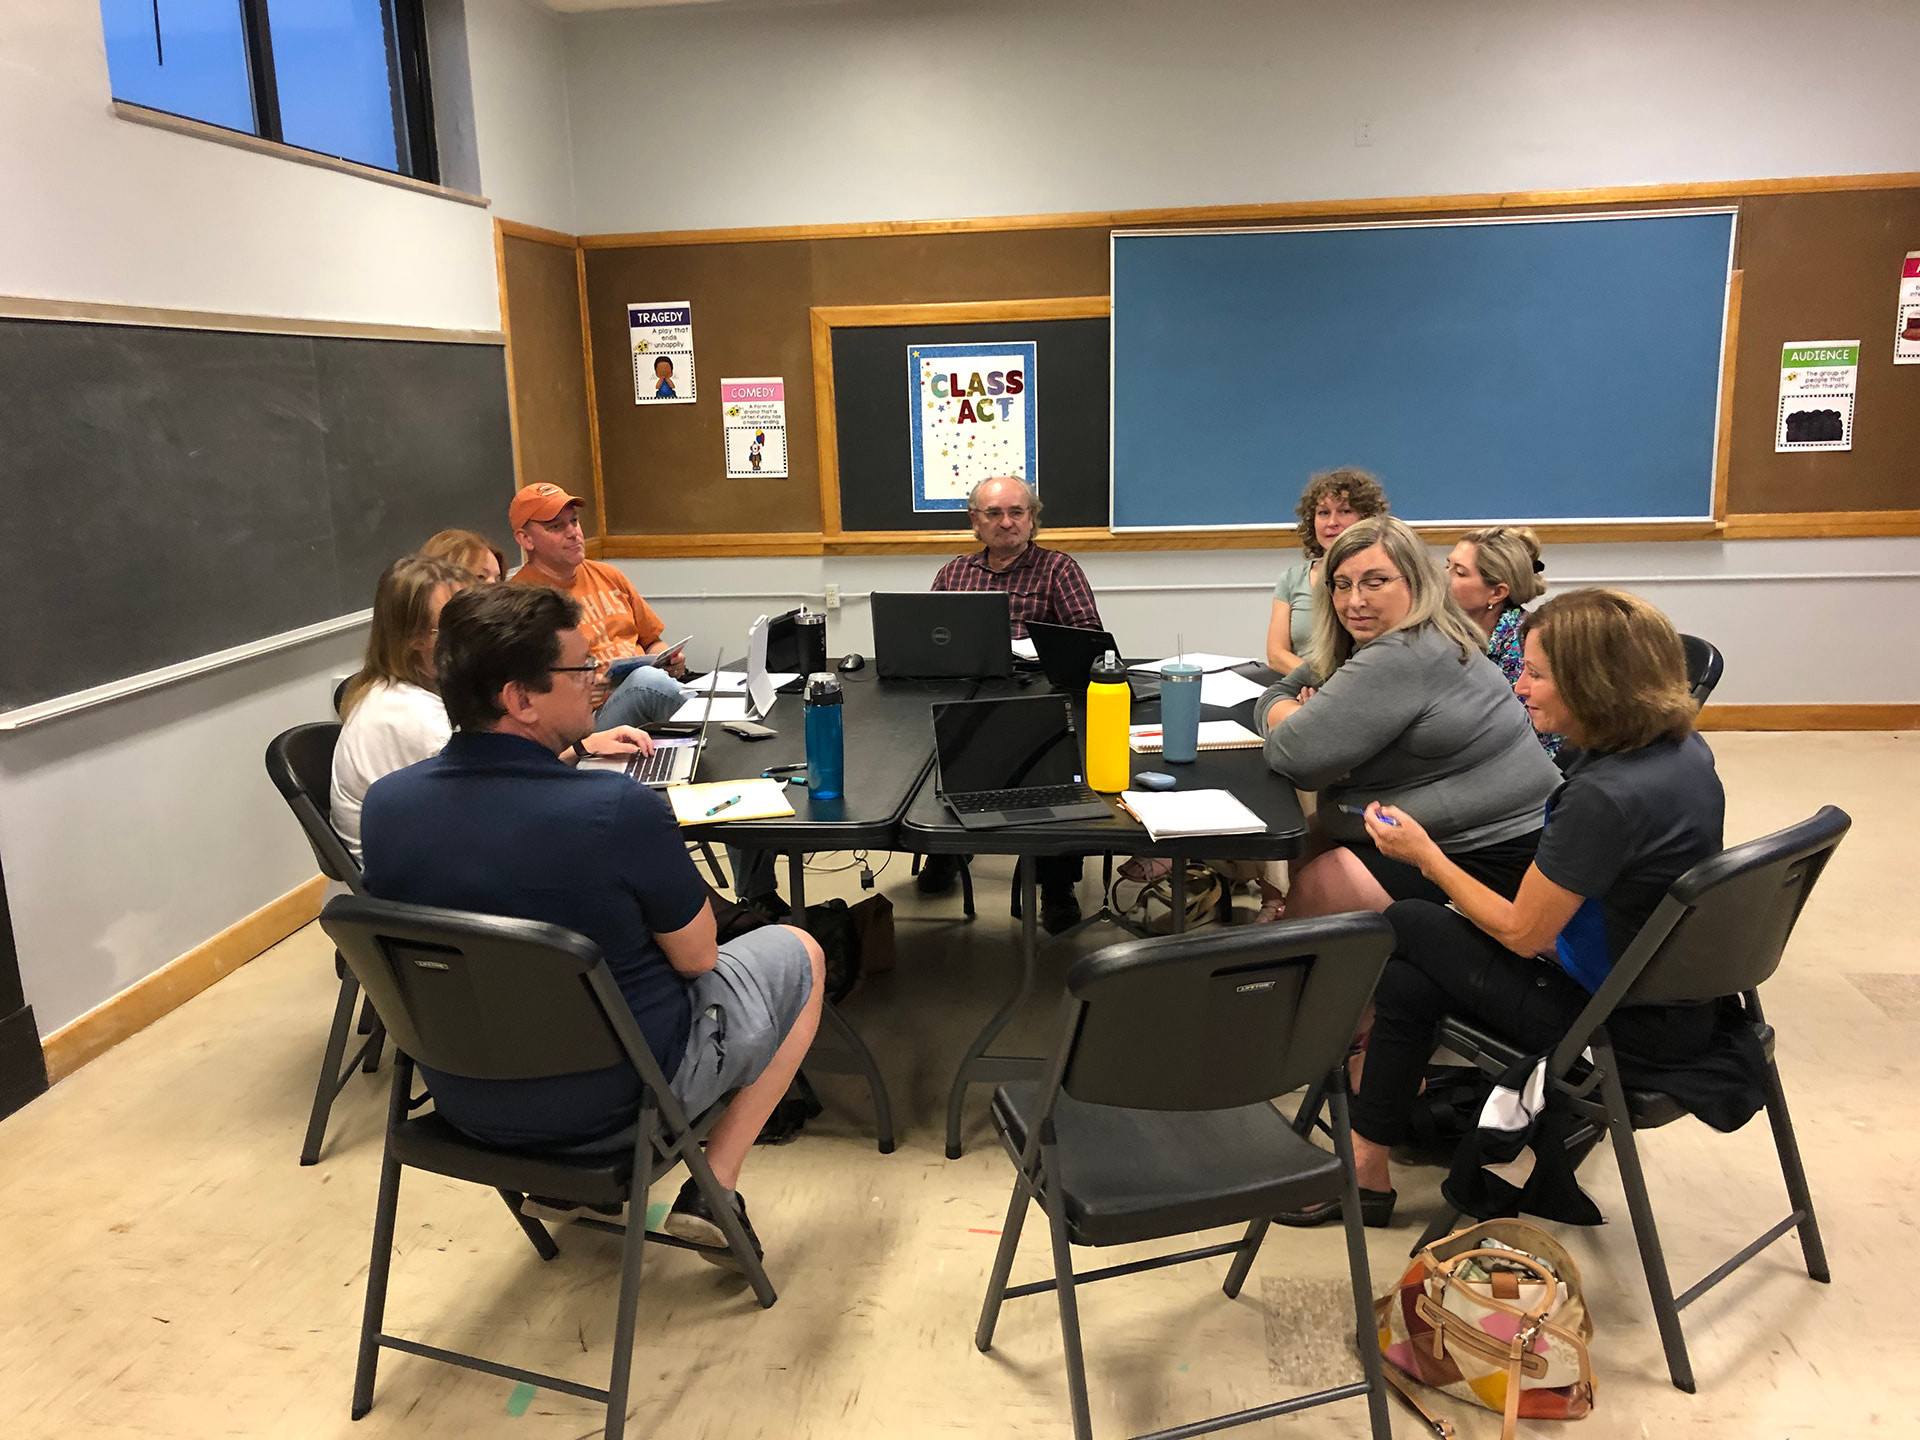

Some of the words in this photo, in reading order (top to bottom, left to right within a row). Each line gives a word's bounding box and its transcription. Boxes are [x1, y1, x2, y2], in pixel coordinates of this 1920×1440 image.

[637, 311, 683, 324] TRAGEDY
[1791, 349, 1850, 361] AUDIENCE
[931, 370, 1024, 398] CLASS
[731, 387, 775, 399] COMEDY
[957, 397, 1014, 424] ACT
